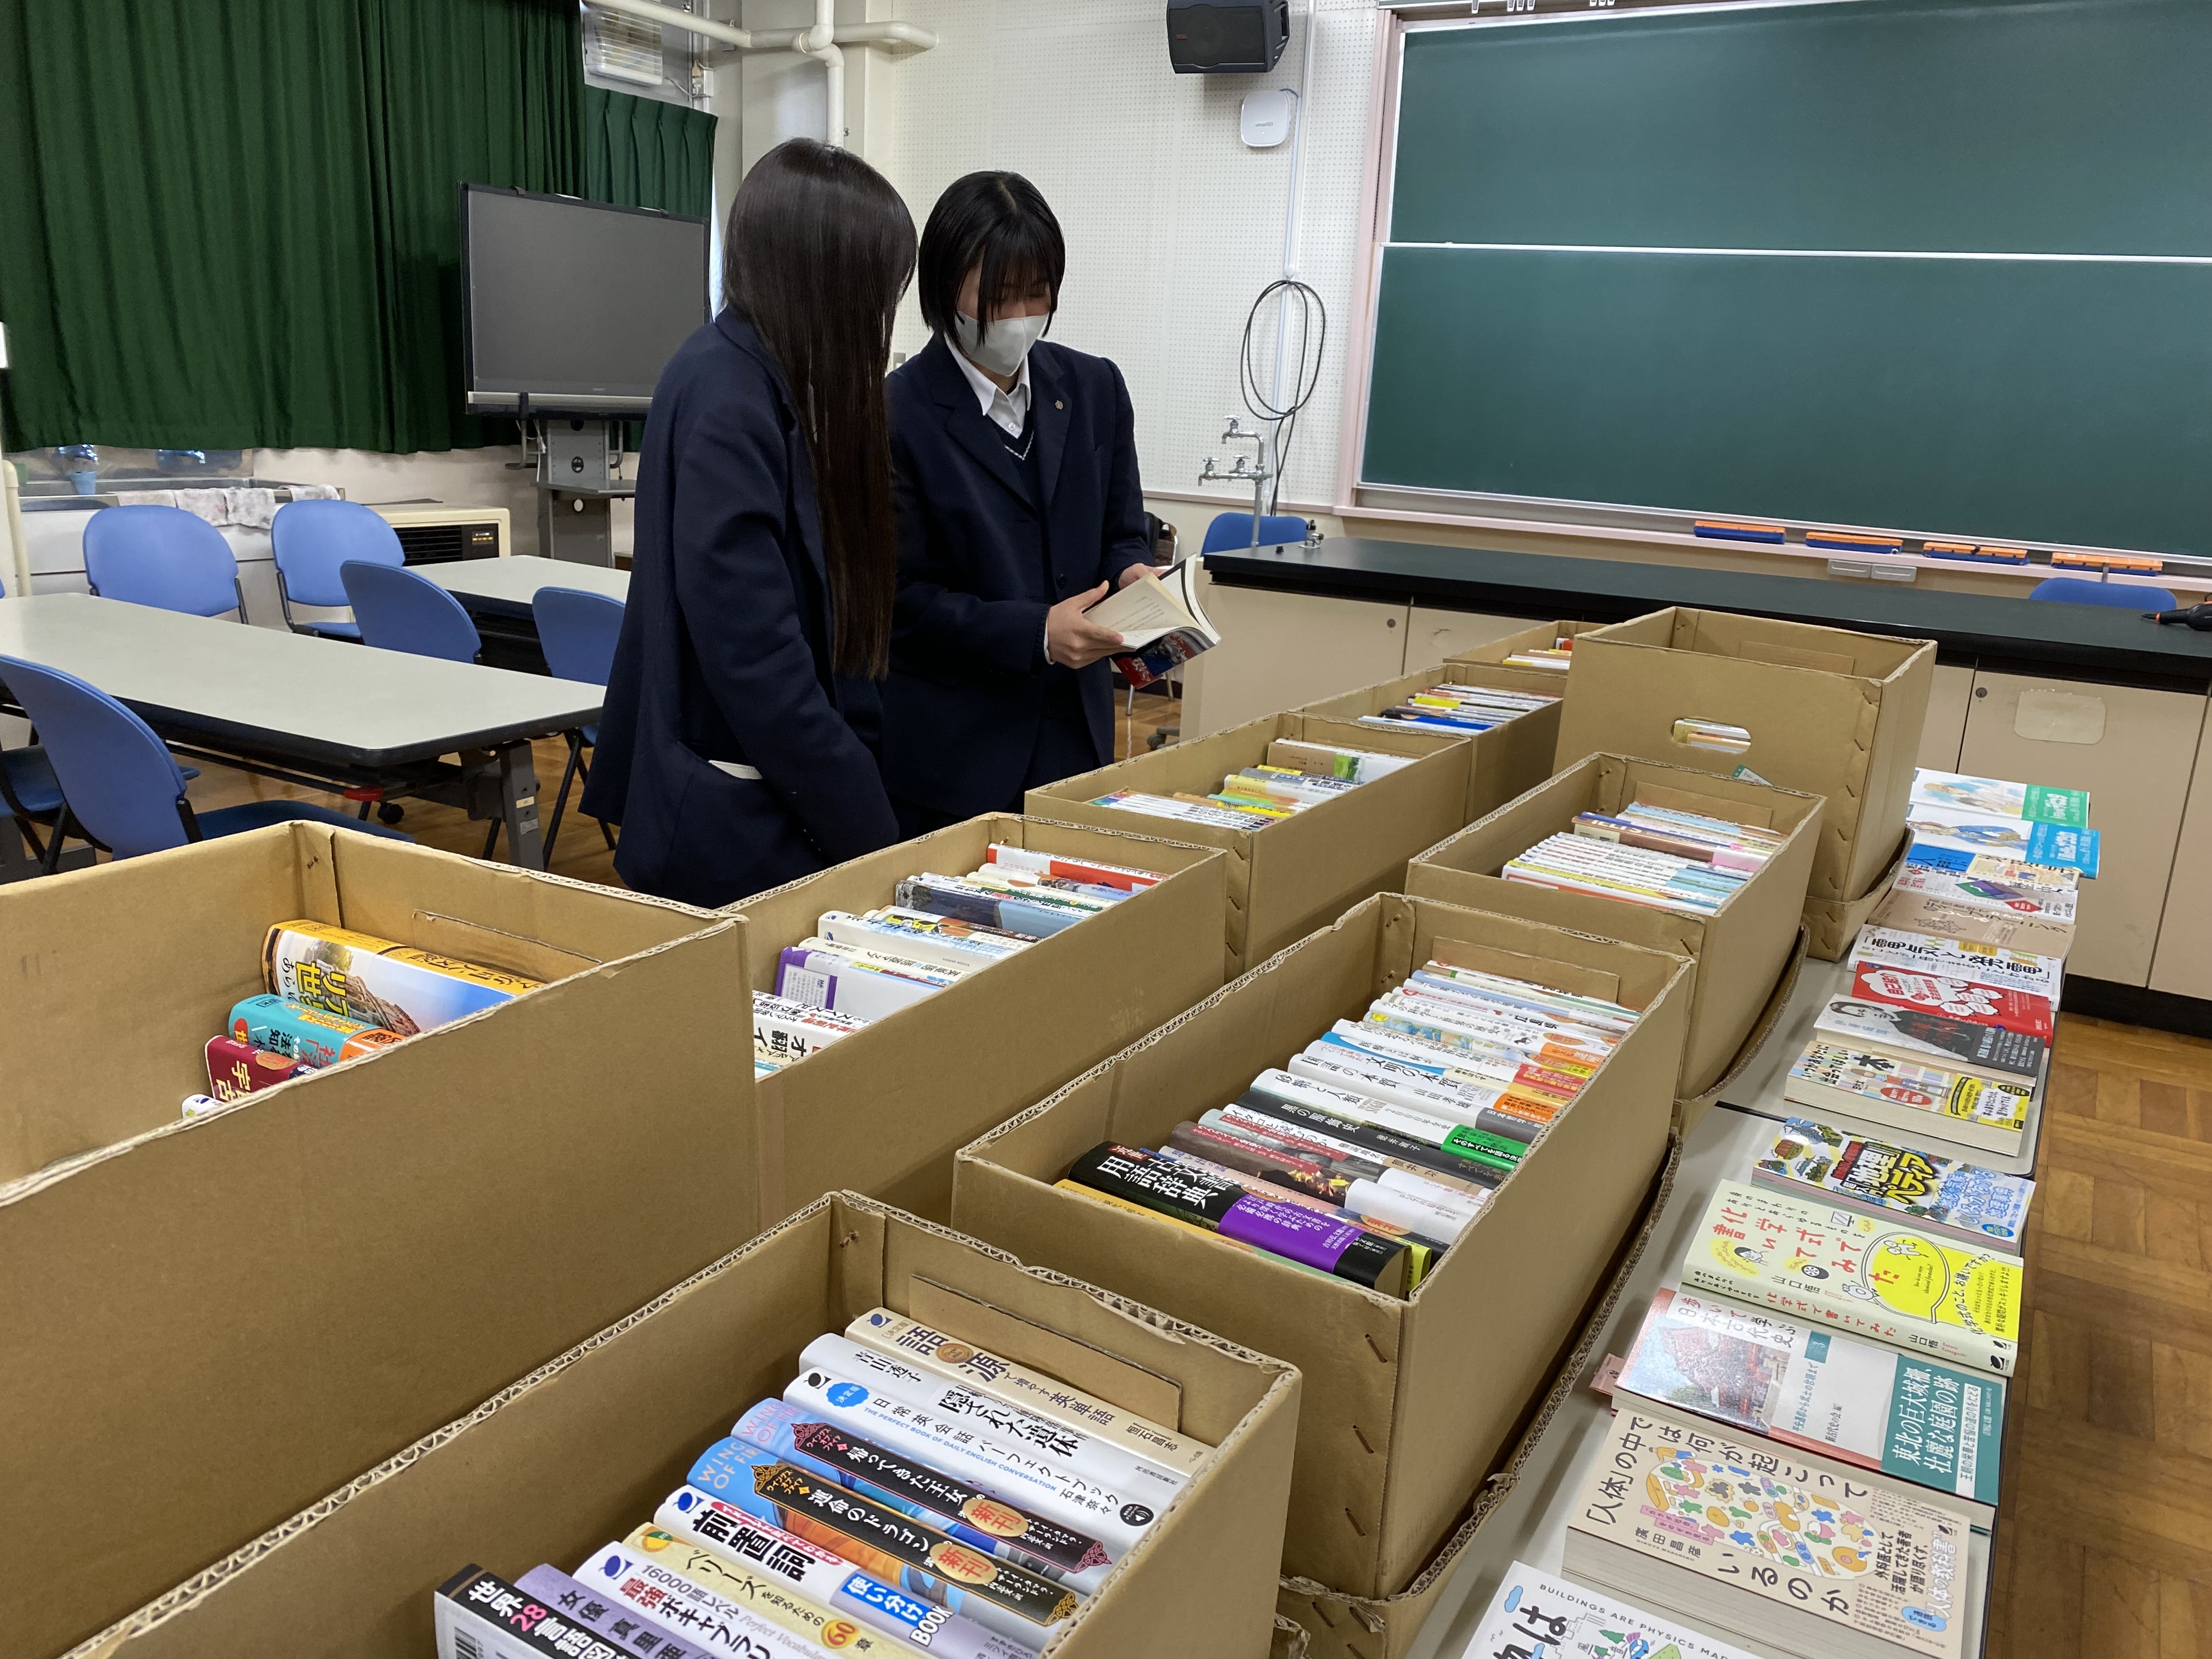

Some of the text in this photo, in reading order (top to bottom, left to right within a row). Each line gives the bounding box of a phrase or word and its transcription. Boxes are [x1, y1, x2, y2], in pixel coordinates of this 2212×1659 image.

[1300, 1054, 1398, 1090] 国語の本質
[1359, 1041, 1432, 1064] 医療とは何か
[1803, 1045, 1830, 1079] いつかあなたに
[1819, 1049, 1849, 1085] 出会ってほしい
[1853, 1054, 1895, 1072] 本
[1273, 1074, 1364, 1105] 砂糖と人類
[1366, 1057, 1462, 1092] 文明の本質
[1412, 1088, 1473, 1109] 山田孝雄
[1280, 1105, 1360, 1135] 黒の服飾史
[1097, 1155, 1220, 1210] 用語辞典
[1146, 1153, 1240, 1196] 古文書
[1886, 1150, 1939, 1206] ペディア
[1243, 1200, 1324, 1233] より深く学ぶための
[1729, 1191, 1809, 1215] 身のまわりの
[1955, 1168, 1996, 1227] しくみがわかる
[1236, 1204, 1300, 1233] 必備必携の辞典
[1720, 1207, 1863, 1252] 化学式で
[1726, 1198, 1866, 1238] ありとあらゆるものを
[1712, 1223, 1900, 1285] 書いてみた
[1694, 1271, 1734, 1285] 身のまわりの
[1694, 1277, 1760, 1299] ありとあらゆるものを
[1771, 1275, 1821, 1294] 山口悟
[1678, 1307, 1794, 1348] 日本古代史
[1680, 1297, 1797, 1334] 歩いて学ぶ
[1767, 1291, 1897, 1337] 化学式で書いてみた
[1909, 1334, 1939, 1349] 山口悟
[852, 1350, 922, 1384] 青山透子
[756, 1422, 778, 1444] OF
[936, 1390, 1081, 1459] 隠された遺体
[1923, 1375, 1962, 1475] 壮麗な庭園の跡
[863, 1407, 1057, 1490] THE PERFECT BOOK OF DAILY ENGLISH CONVERSATION
[872, 1397, 1119, 1506] 日常英会話パーフェクトブック
[1657, 1425, 1869, 1499] は何が起こって
[713, 1465, 737, 1490] OF
[847, 1446, 968, 1506] 帰ってきた王女
[1585, 1416, 1654, 1526] 「人体」の中で
[807, 1488, 930, 1554] 運命のドラゴン
[970, 1503, 1024, 1533] 新刊
[1059, 1487, 1111, 1516] 石津奈々
[692, 1508, 816, 1583] 前置詞
[936, 1547, 992, 1579] 新刊
[1874, 1531, 1894, 1581] 外科医として
[1891, 1530, 1912, 1595] 活躍してきた著者
[640, 1564, 776, 1638] 16000語レベル Perfect
[685, 1548, 874, 1652] ベリーズを知るための60章
[1718, 1553, 1850, 1616] いるのか
[467, 1580, 629, 1659] 世界28言語図
[557, 1589, 608, 1622] 女優
[846, 1575, 956, 1647] 使い分け BOOK
[1539, 1584, 1695, 1650] BUILDINGS ARE PHYSICS
